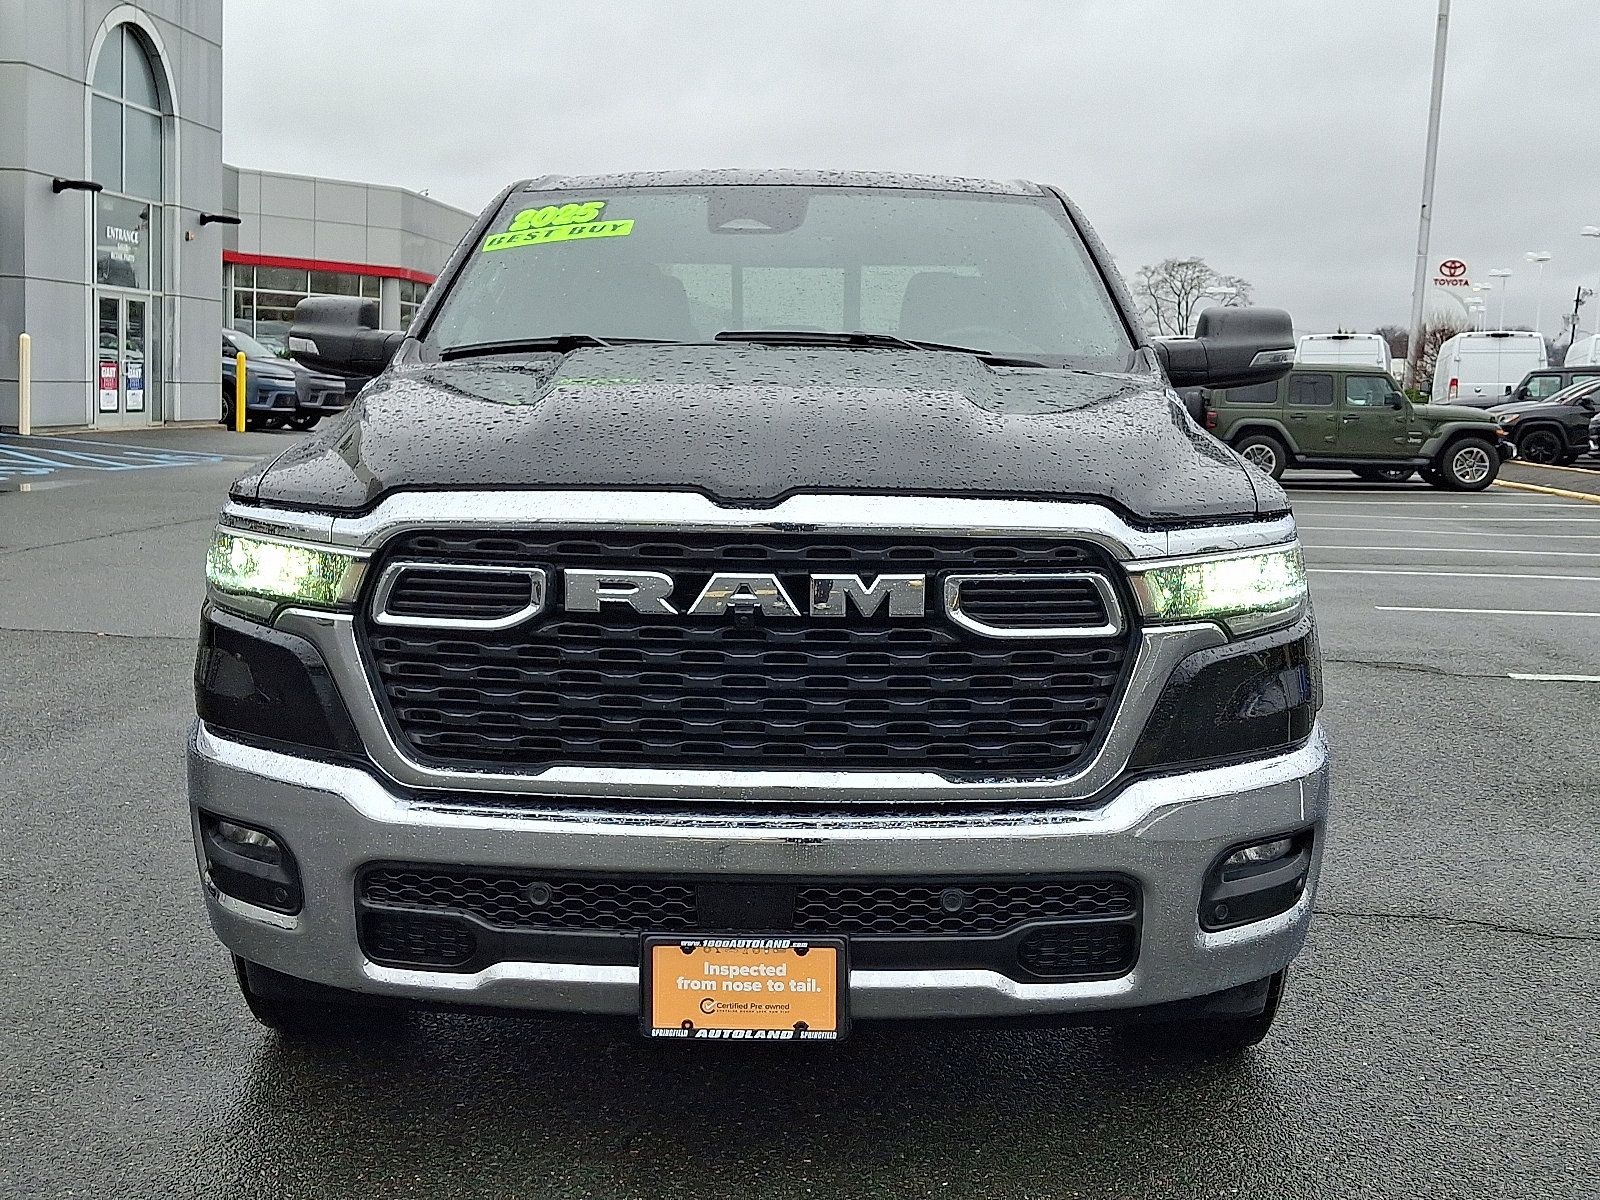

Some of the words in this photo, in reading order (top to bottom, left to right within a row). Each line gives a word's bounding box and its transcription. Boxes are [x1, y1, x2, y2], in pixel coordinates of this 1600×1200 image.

[509, 201, 606, 232] 2025
[106, 225, 139, 244] ENTRANCE
[487, 229, 558, 247] BEST
[567, 223, 625, 236] BUY
[1433, 278, 1470, 287] TOYOTA
[564, 568, 926, 617] RAM
[703, 961, 788, 979] Inspected
[676, 976, 717, 991] from
[722, 979, 763, 992] nose
[766, 979, 785, 992] to
[789, 977, 822, 993] tail.
[716, 1002, 748, 1010] Certified
[651, 1028, 689, 1037] SPRINGFIELD
[694, 1029, 794, 1040] AUTOLAND
[799, 1031, 838, 1040] SPRINGFIELD
